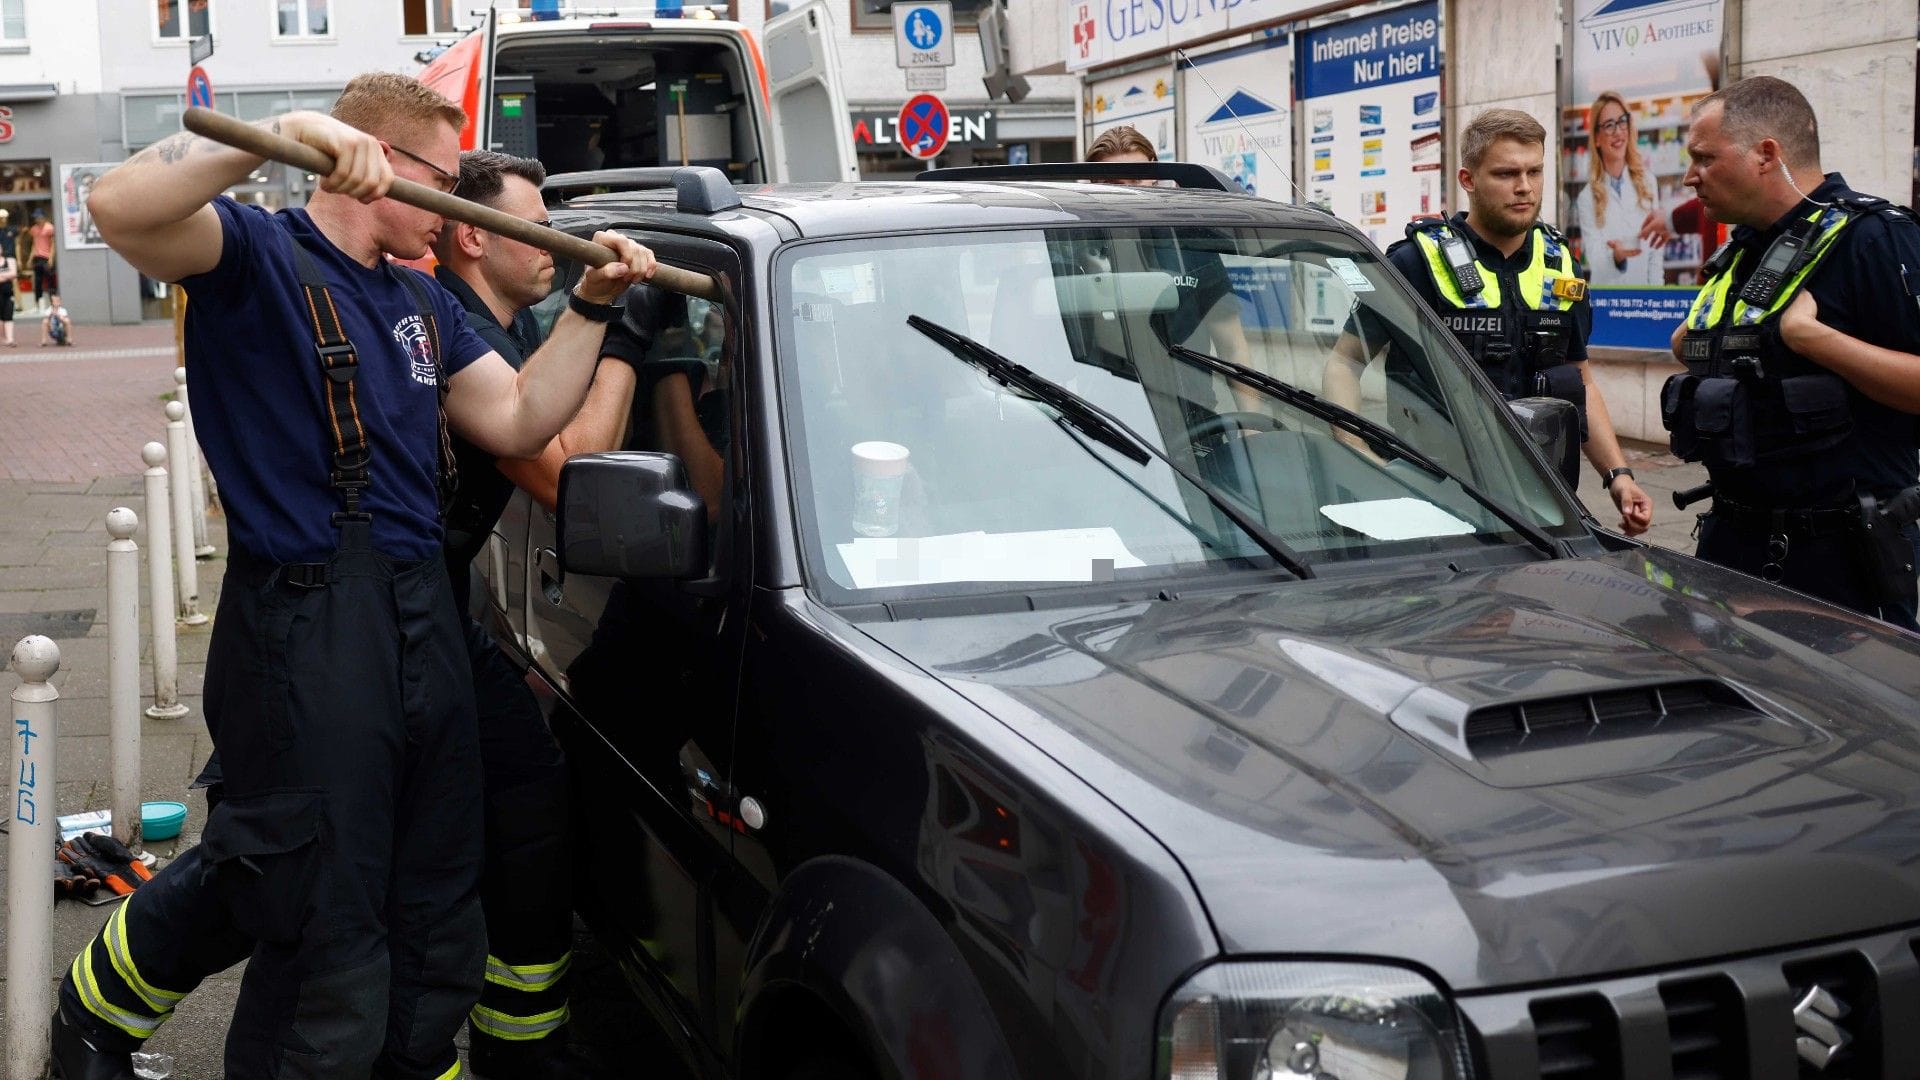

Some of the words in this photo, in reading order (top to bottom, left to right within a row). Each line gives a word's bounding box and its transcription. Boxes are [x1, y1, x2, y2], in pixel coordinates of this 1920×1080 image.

[1106, 0, 1244, 42] GES
[1312, 27, 1377, 62] Internet
[1381, 17, 1436, 49] Preise
[911, 52, 942, 64] ZONE
[1353, 58, 1385, 84] Nur
[1388, 50, 1425, 78] hier
[1429, 44, 1436, 70] !
[1442, 316, 1503, 332] POLIZEI
